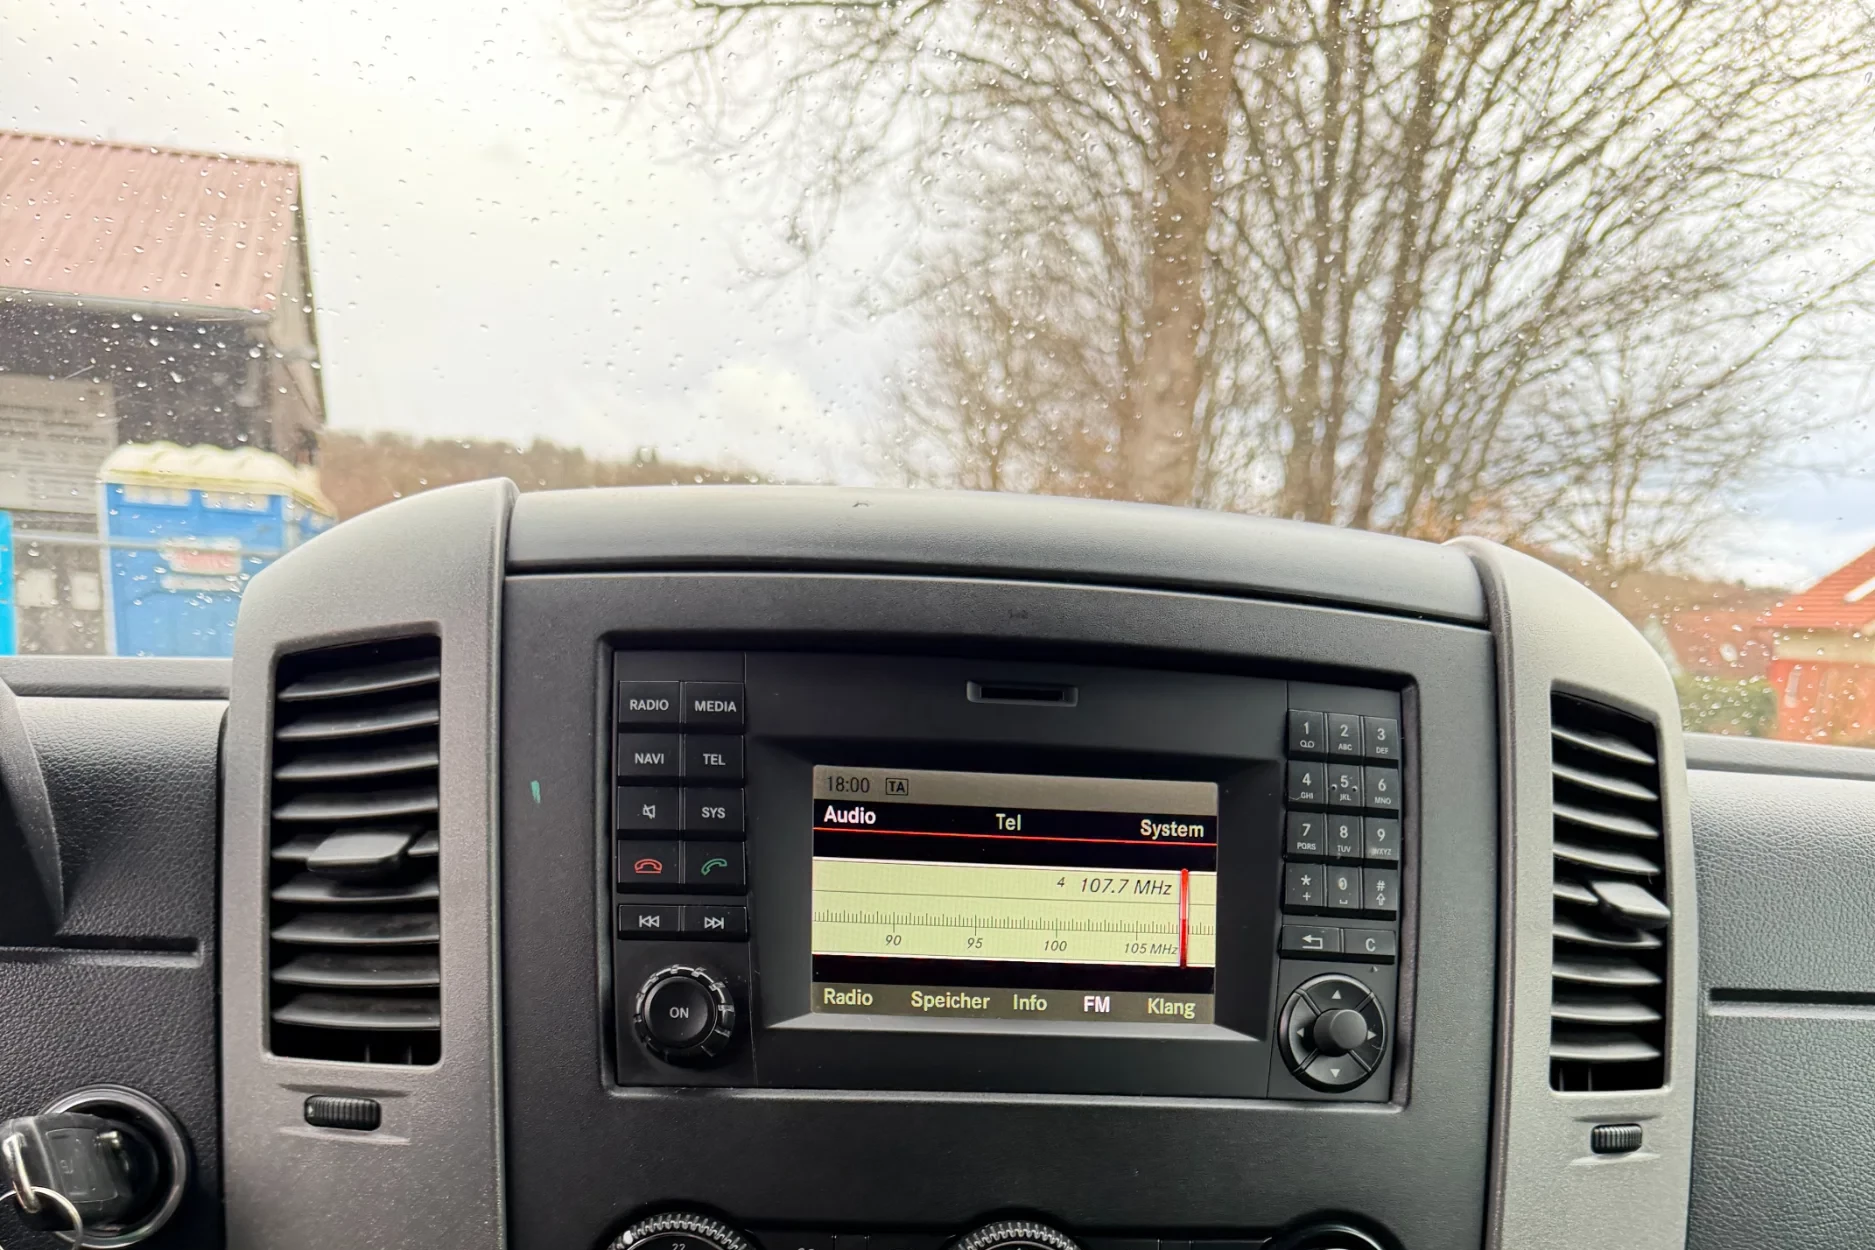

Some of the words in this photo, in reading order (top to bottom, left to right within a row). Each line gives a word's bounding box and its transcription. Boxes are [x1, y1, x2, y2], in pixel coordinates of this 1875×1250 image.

[629, 699, 669, 711] RADIO
[694, 700, 737, 712] MEDIA
[1303, 721, 1309, 735] 1
[1340, 724, 1349, 737] 2
[1377, 728, 1386, 741] 3
[1338, 743, 1352, 751] ABC
[1375, 746, 1389, 754] DEF
[634, 753, 665, 764] NAVI
[703, 753, 726, 765] TEL
[826, 775, 870, 793] 18:00
[1302, 773, 1311, 786] 4
[1340, 775, 1349, 788] 5
[1378, 778, 1387, 792] 6
[888, 780, 906, 793] TA
[1339, 793, 1352, 801] JKL
[1374, 797, 1392, 805] MNO
[701, 807, 726, 819] SYS
[823, 805, 876, 825] Audio
[995, 813, 1021, 831] Tel
[1140, 818, 1205, 840] System
[1302, 823, 1311, 837] 7
[1339, 825, 1349, 839] 8
[1376, 828, 1386, 841] 9
[1296, 842, 1316, 850] PQRS
[1337, 844, 1352, 853] TUV
[1056, 876, 1066, 888] 4
[1080, 877, 1130, 894] 107.7
[1133, 879, 1172, 896] MHz
[1338, 877, 1348, 890] 0
[885, 934, 902, 947] 90
[967, 937, 983, 949] 95
[1043, 939, 1067, 952] 100
[1124, 942, 1147, 954] 105
[1149, 943, 1178, 956] MHz
[1365, 938, 1376, 952] C
[823, 987, 873, 1006] Radio
[910, 990, 990, 1012] Speicher
[1013, 993, 1048, 1011] Info
[1083, 995, 1111, 1013] FM
[1147, 997, 1196, 1020] Klang
[669, 1006, 690, 1019] ON
